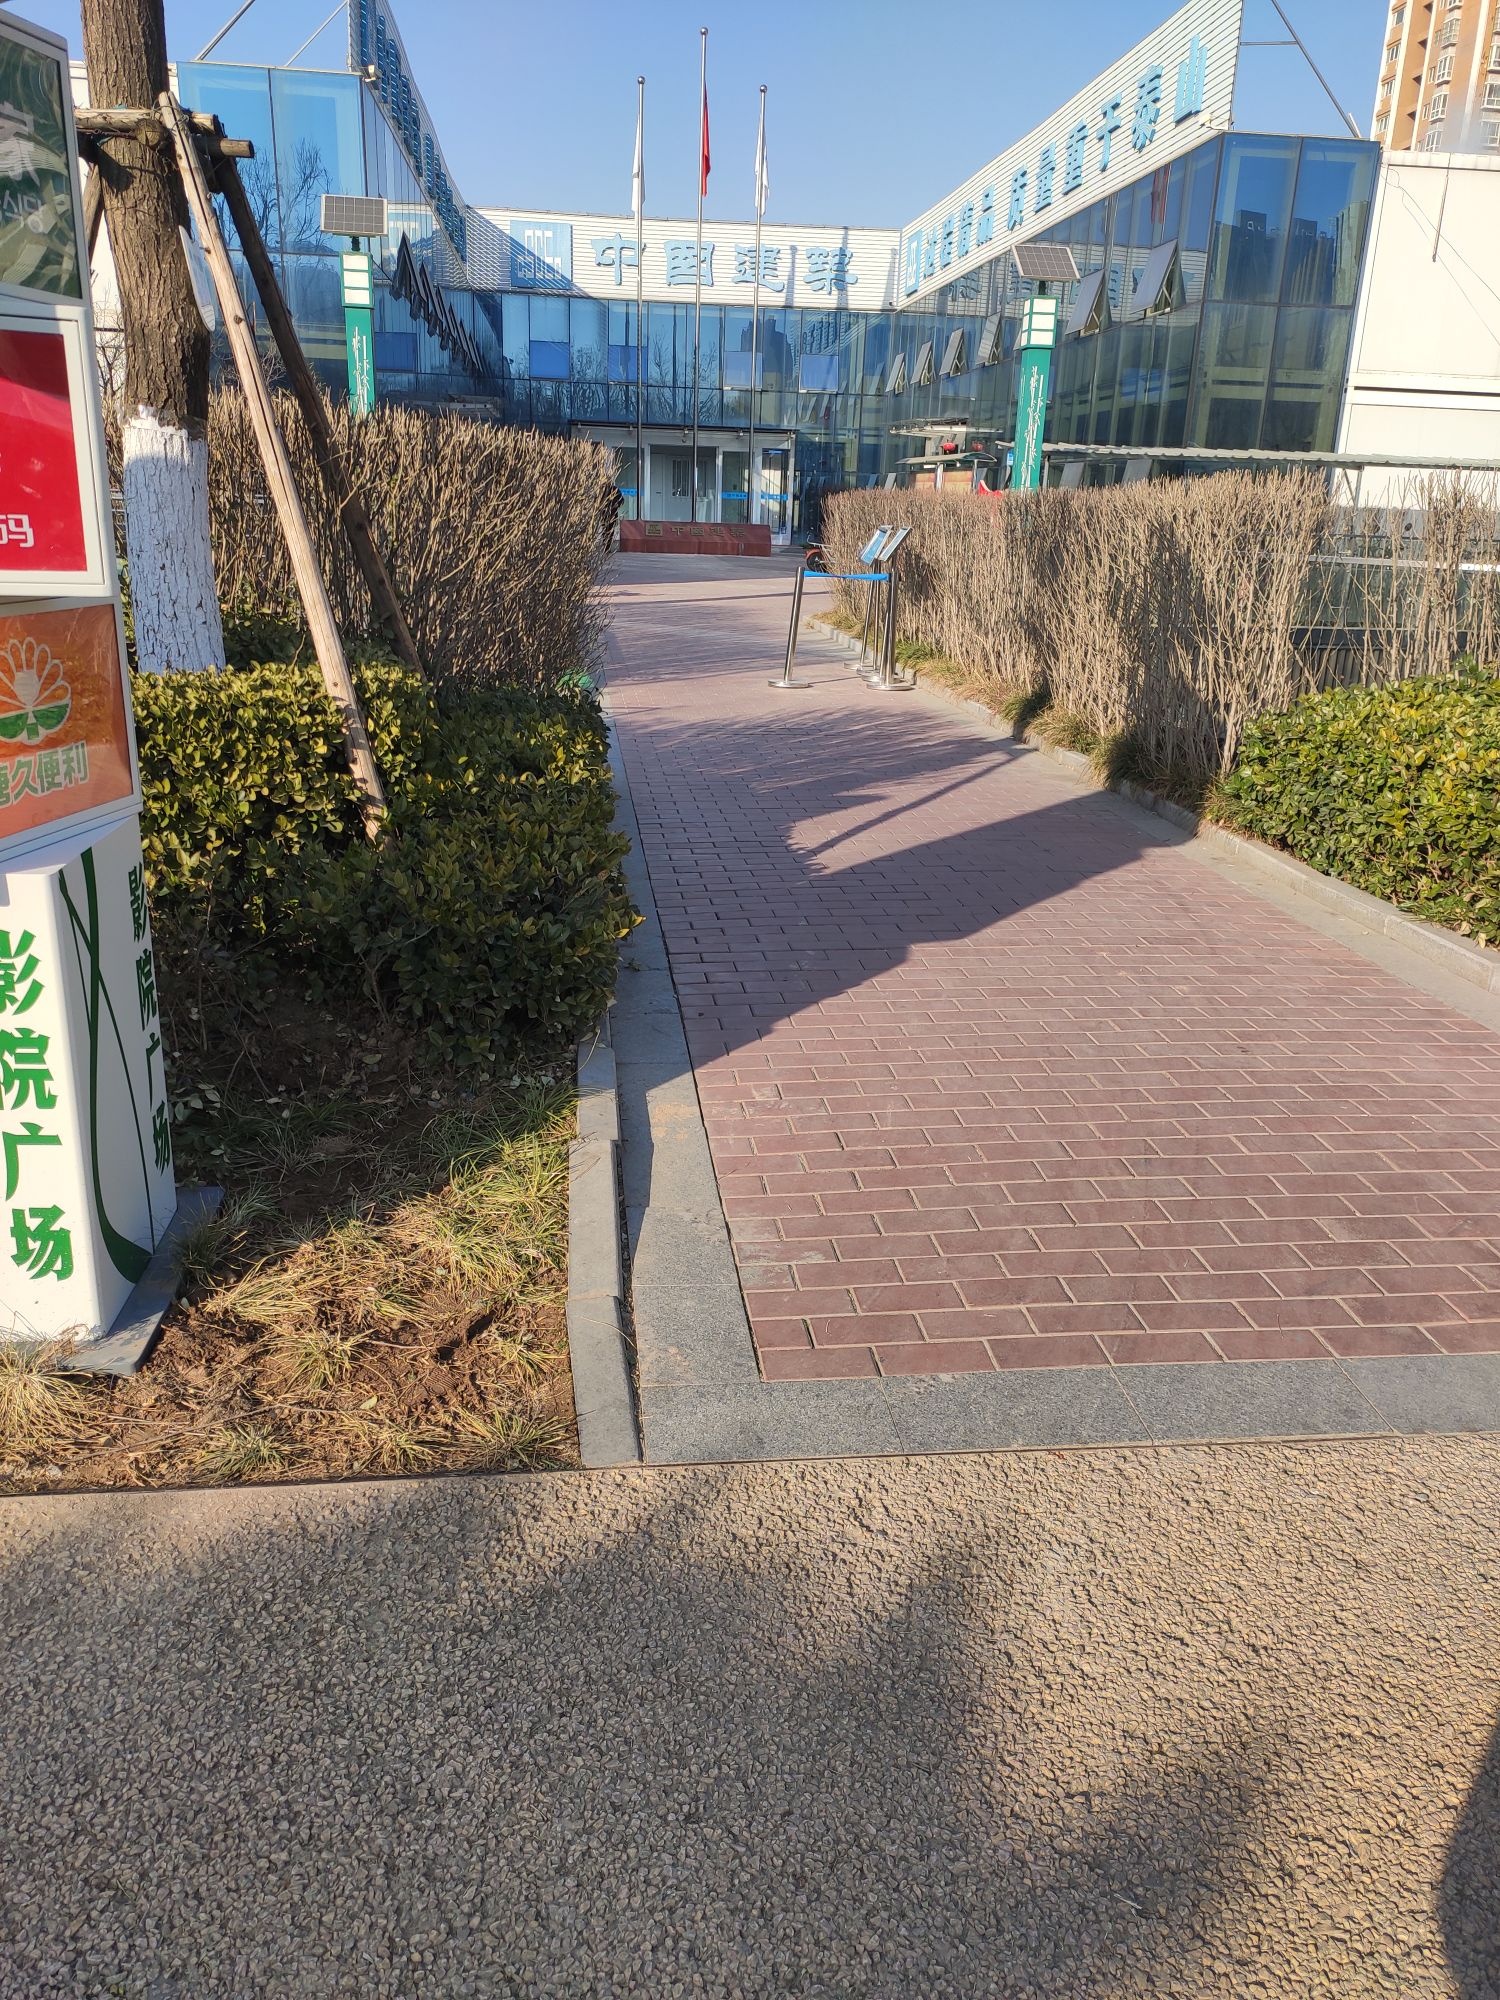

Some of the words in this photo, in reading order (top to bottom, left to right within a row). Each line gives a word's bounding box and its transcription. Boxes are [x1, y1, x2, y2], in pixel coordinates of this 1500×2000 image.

[0, 929, 75, 1282] 影院广场
[128, 861, 172, 1177] 影院广场
